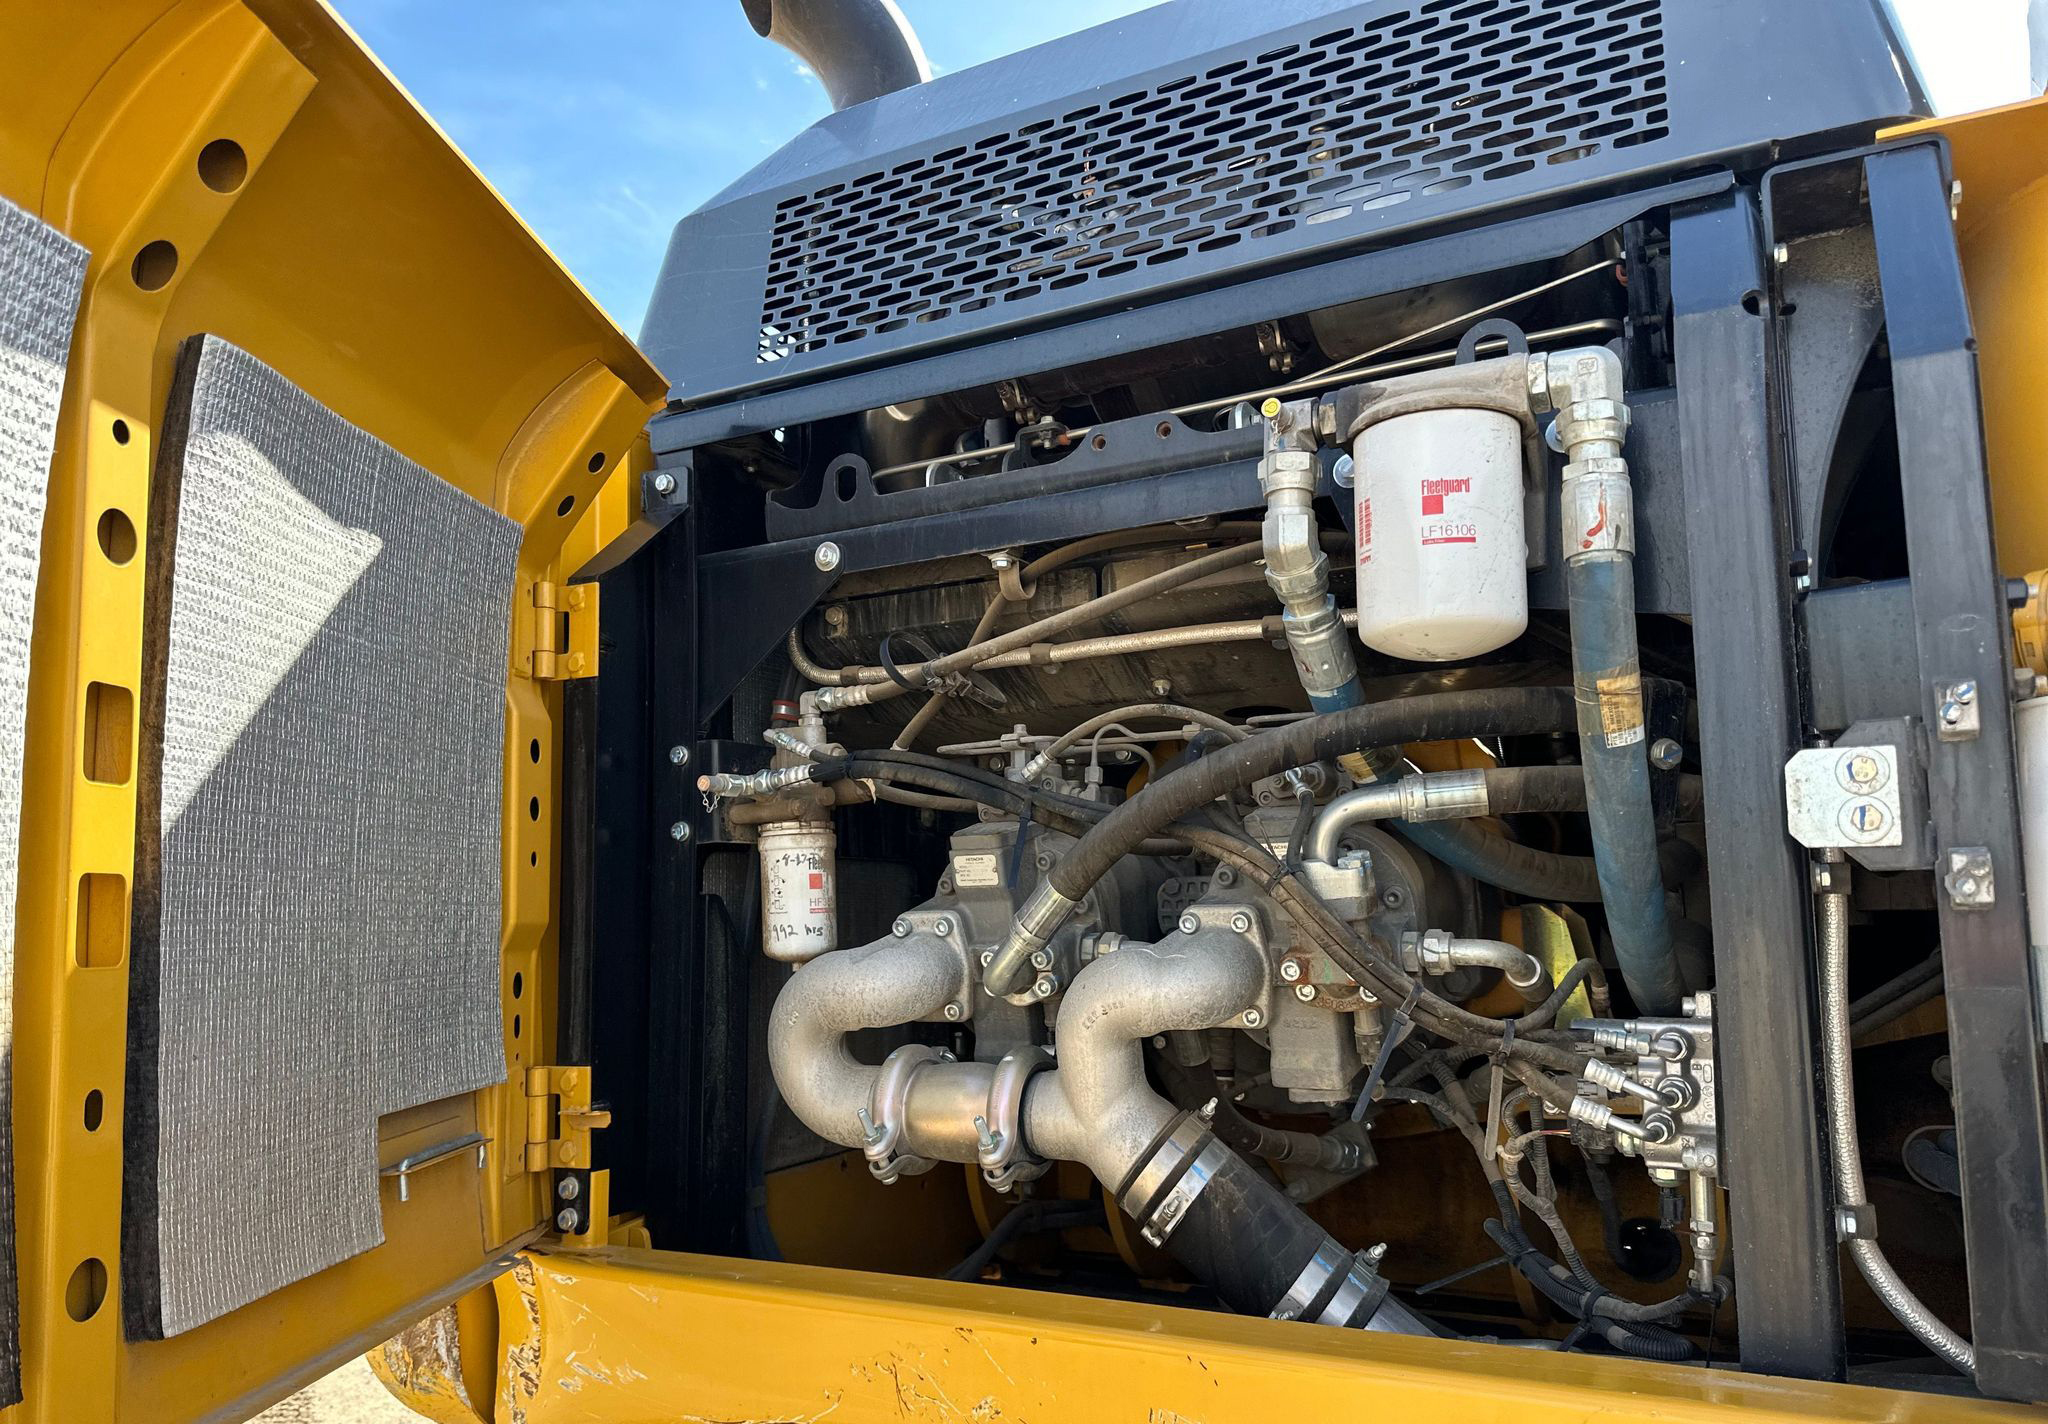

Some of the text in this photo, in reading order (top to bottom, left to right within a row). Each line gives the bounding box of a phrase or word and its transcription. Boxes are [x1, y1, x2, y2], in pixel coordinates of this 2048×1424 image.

[1421, 477, 1470, 496] Fleetguard
[1421, 524, 1476, 538] LF16106
[772, 924, 823, 942] 992 hrs
